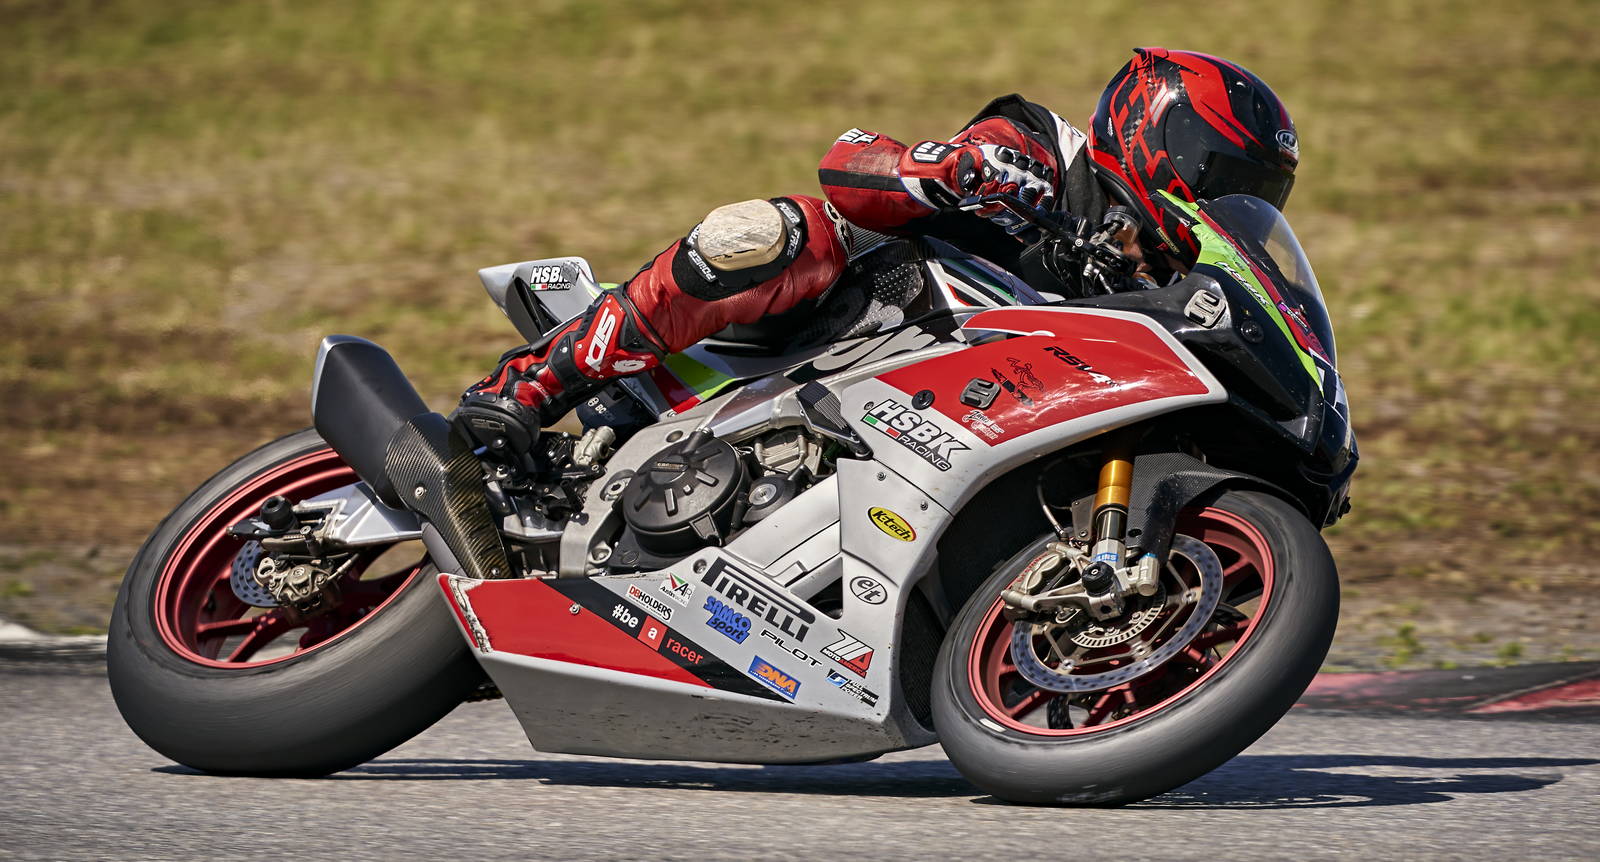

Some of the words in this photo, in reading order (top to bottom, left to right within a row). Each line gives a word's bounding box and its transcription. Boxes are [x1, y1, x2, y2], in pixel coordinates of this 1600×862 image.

[1282, 133, 1297, 148] HJ
[776, 202, 801, 224] POWER
[687, 222, 703, 245] FAC
[687, 249, 716, 281] POWER
[868, 399, 970, 461] HSBK
[898, 435, 951, 471] RACING
[629, 585, 673, 621] DBHOLDERS
[700, 556, 816, 643] PIRELLI
[703, 596, 751, 632] SAMCO
[612, 603, 639, 628] #be
[647, 627, 658, 640] a
[666, 638, 704, 665] racer
[711, 617, 745, 640] sport
[760, 629, 823, 666] PILOT
[757, 663, 798, 693] DNA
